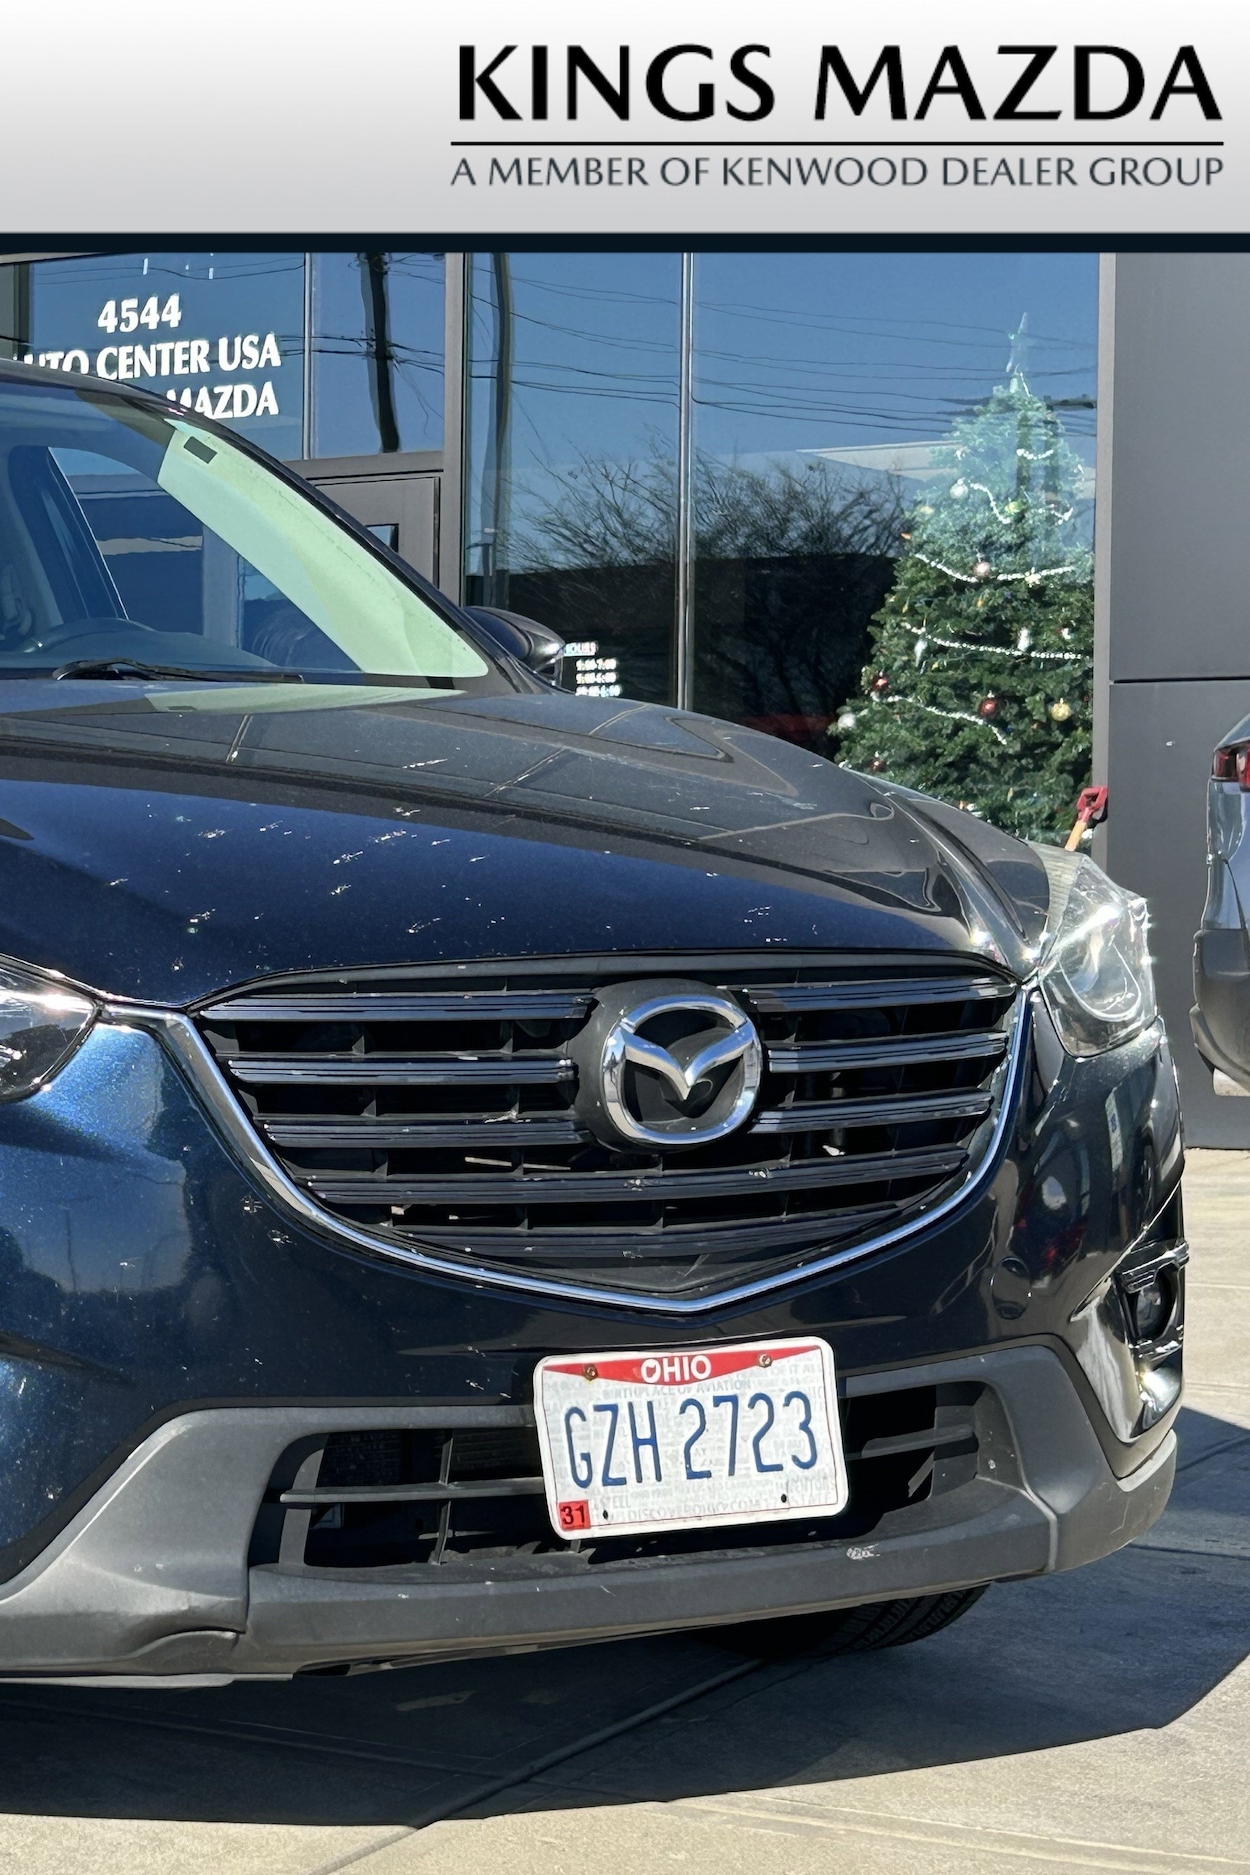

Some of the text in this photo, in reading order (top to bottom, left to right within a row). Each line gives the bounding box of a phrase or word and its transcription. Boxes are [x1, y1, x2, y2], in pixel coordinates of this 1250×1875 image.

[97, 293, 182, 333] 4544
[13, 332, 282, 380] TO CENTER USA
[641, 1354, 712, 1383] OHIO
[564, 1391, 818, 1488] GZH 2723
[560, 1505, 586, 1525] 31
